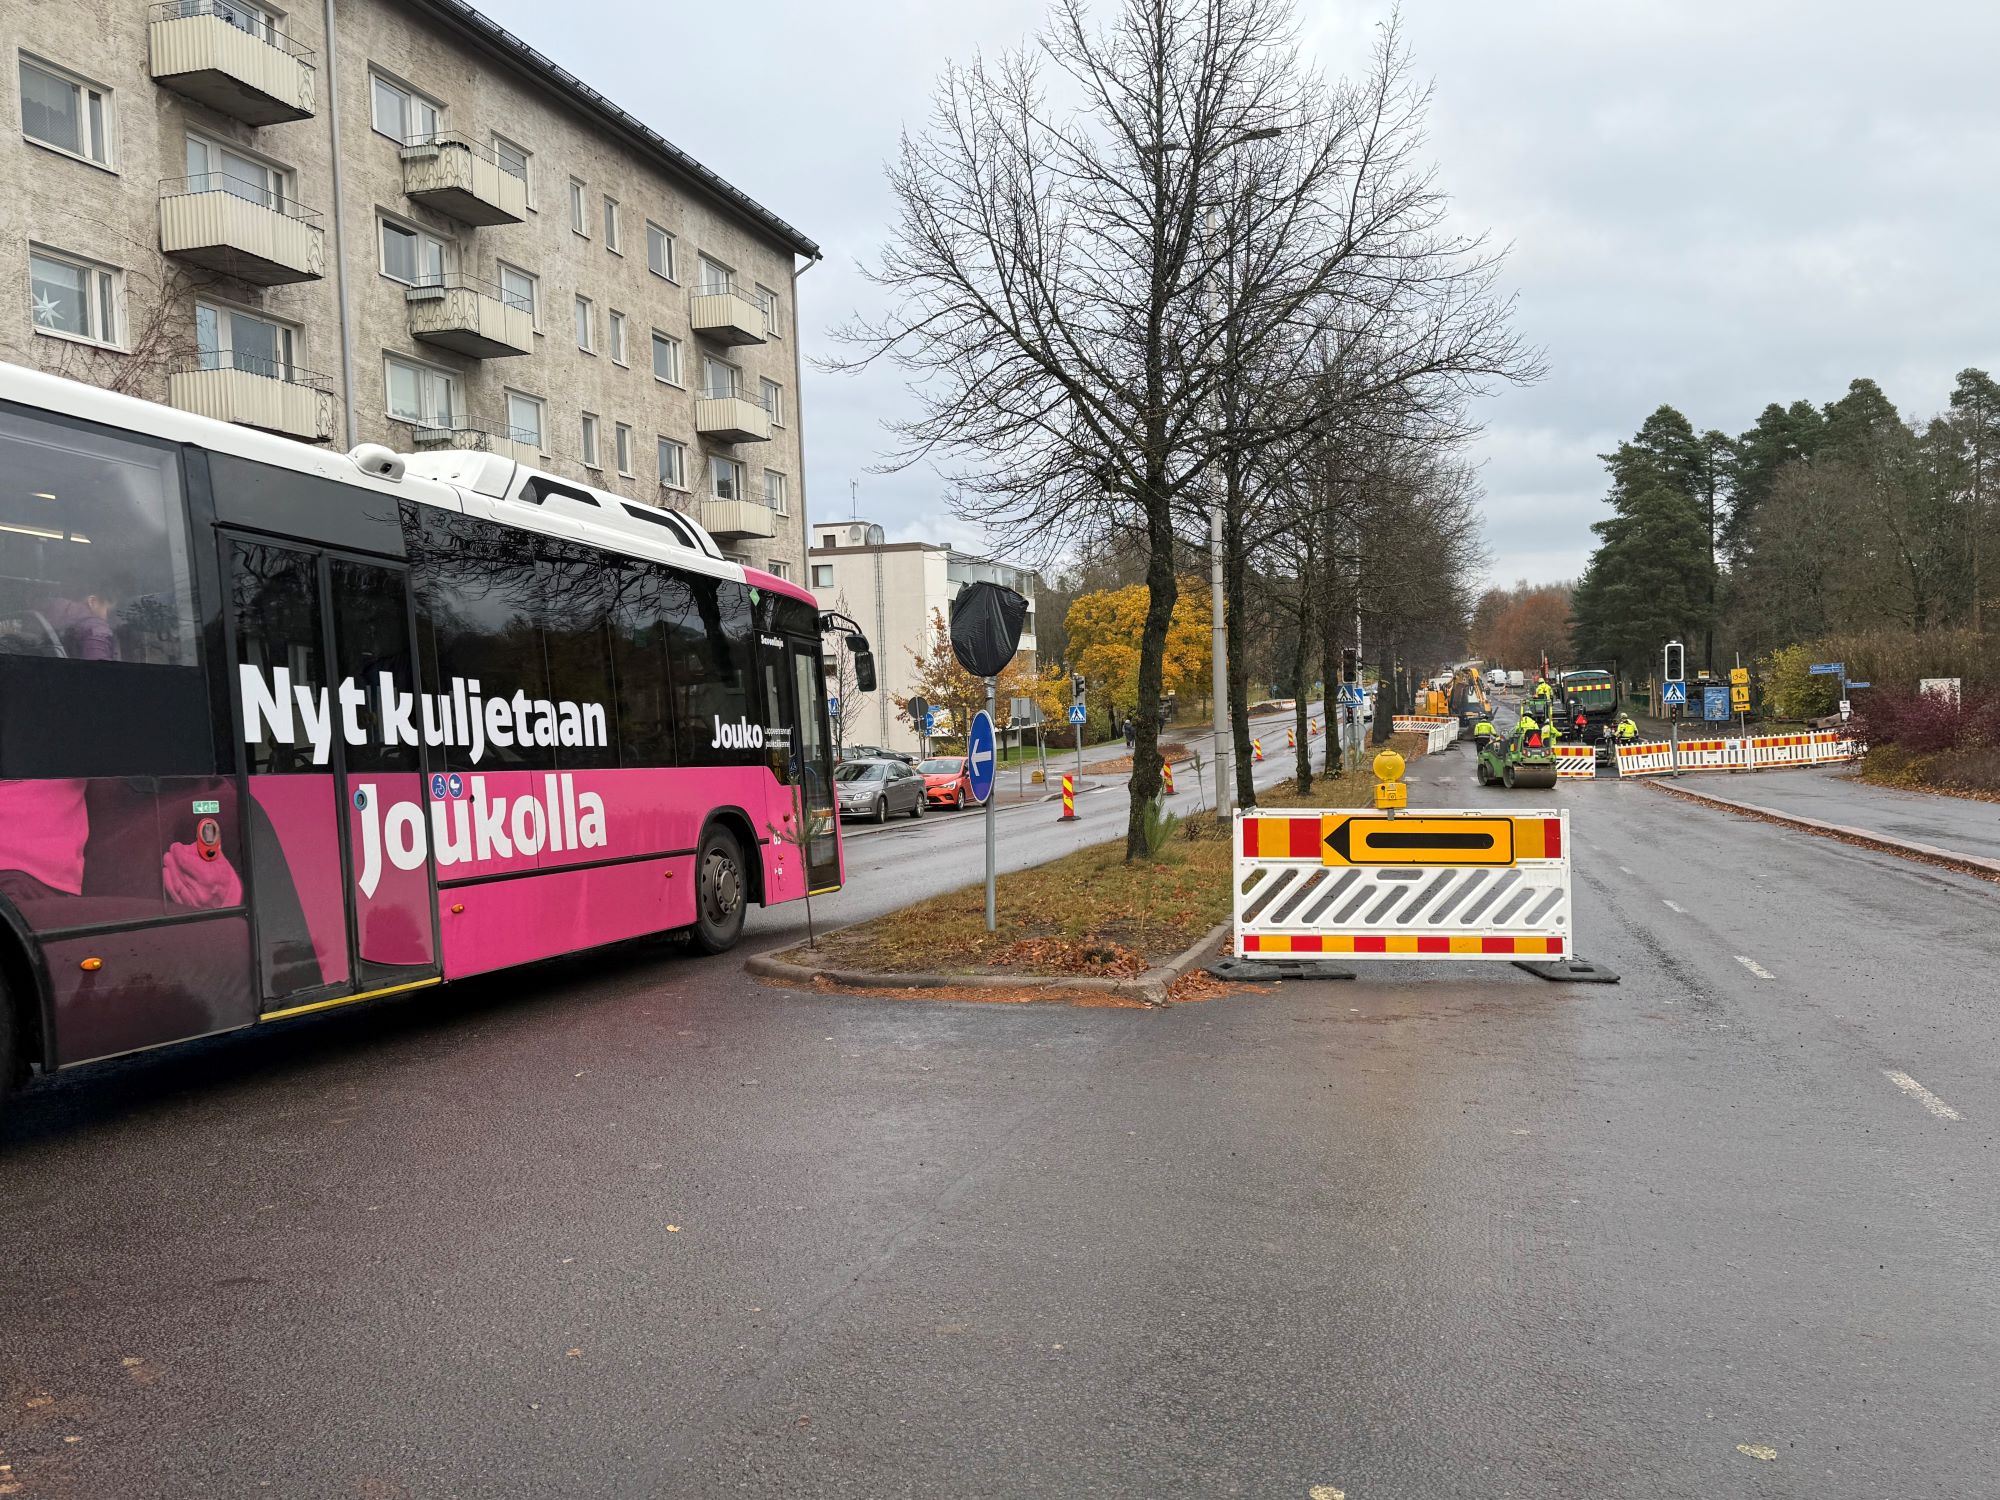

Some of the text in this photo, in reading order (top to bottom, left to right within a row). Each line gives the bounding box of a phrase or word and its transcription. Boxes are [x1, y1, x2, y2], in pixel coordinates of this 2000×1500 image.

[239, 664, 608, 765] Nyt kuljetaan
[711, 714, 763, 749] Jouko
[358, 773, 608, 900] Joukolla
